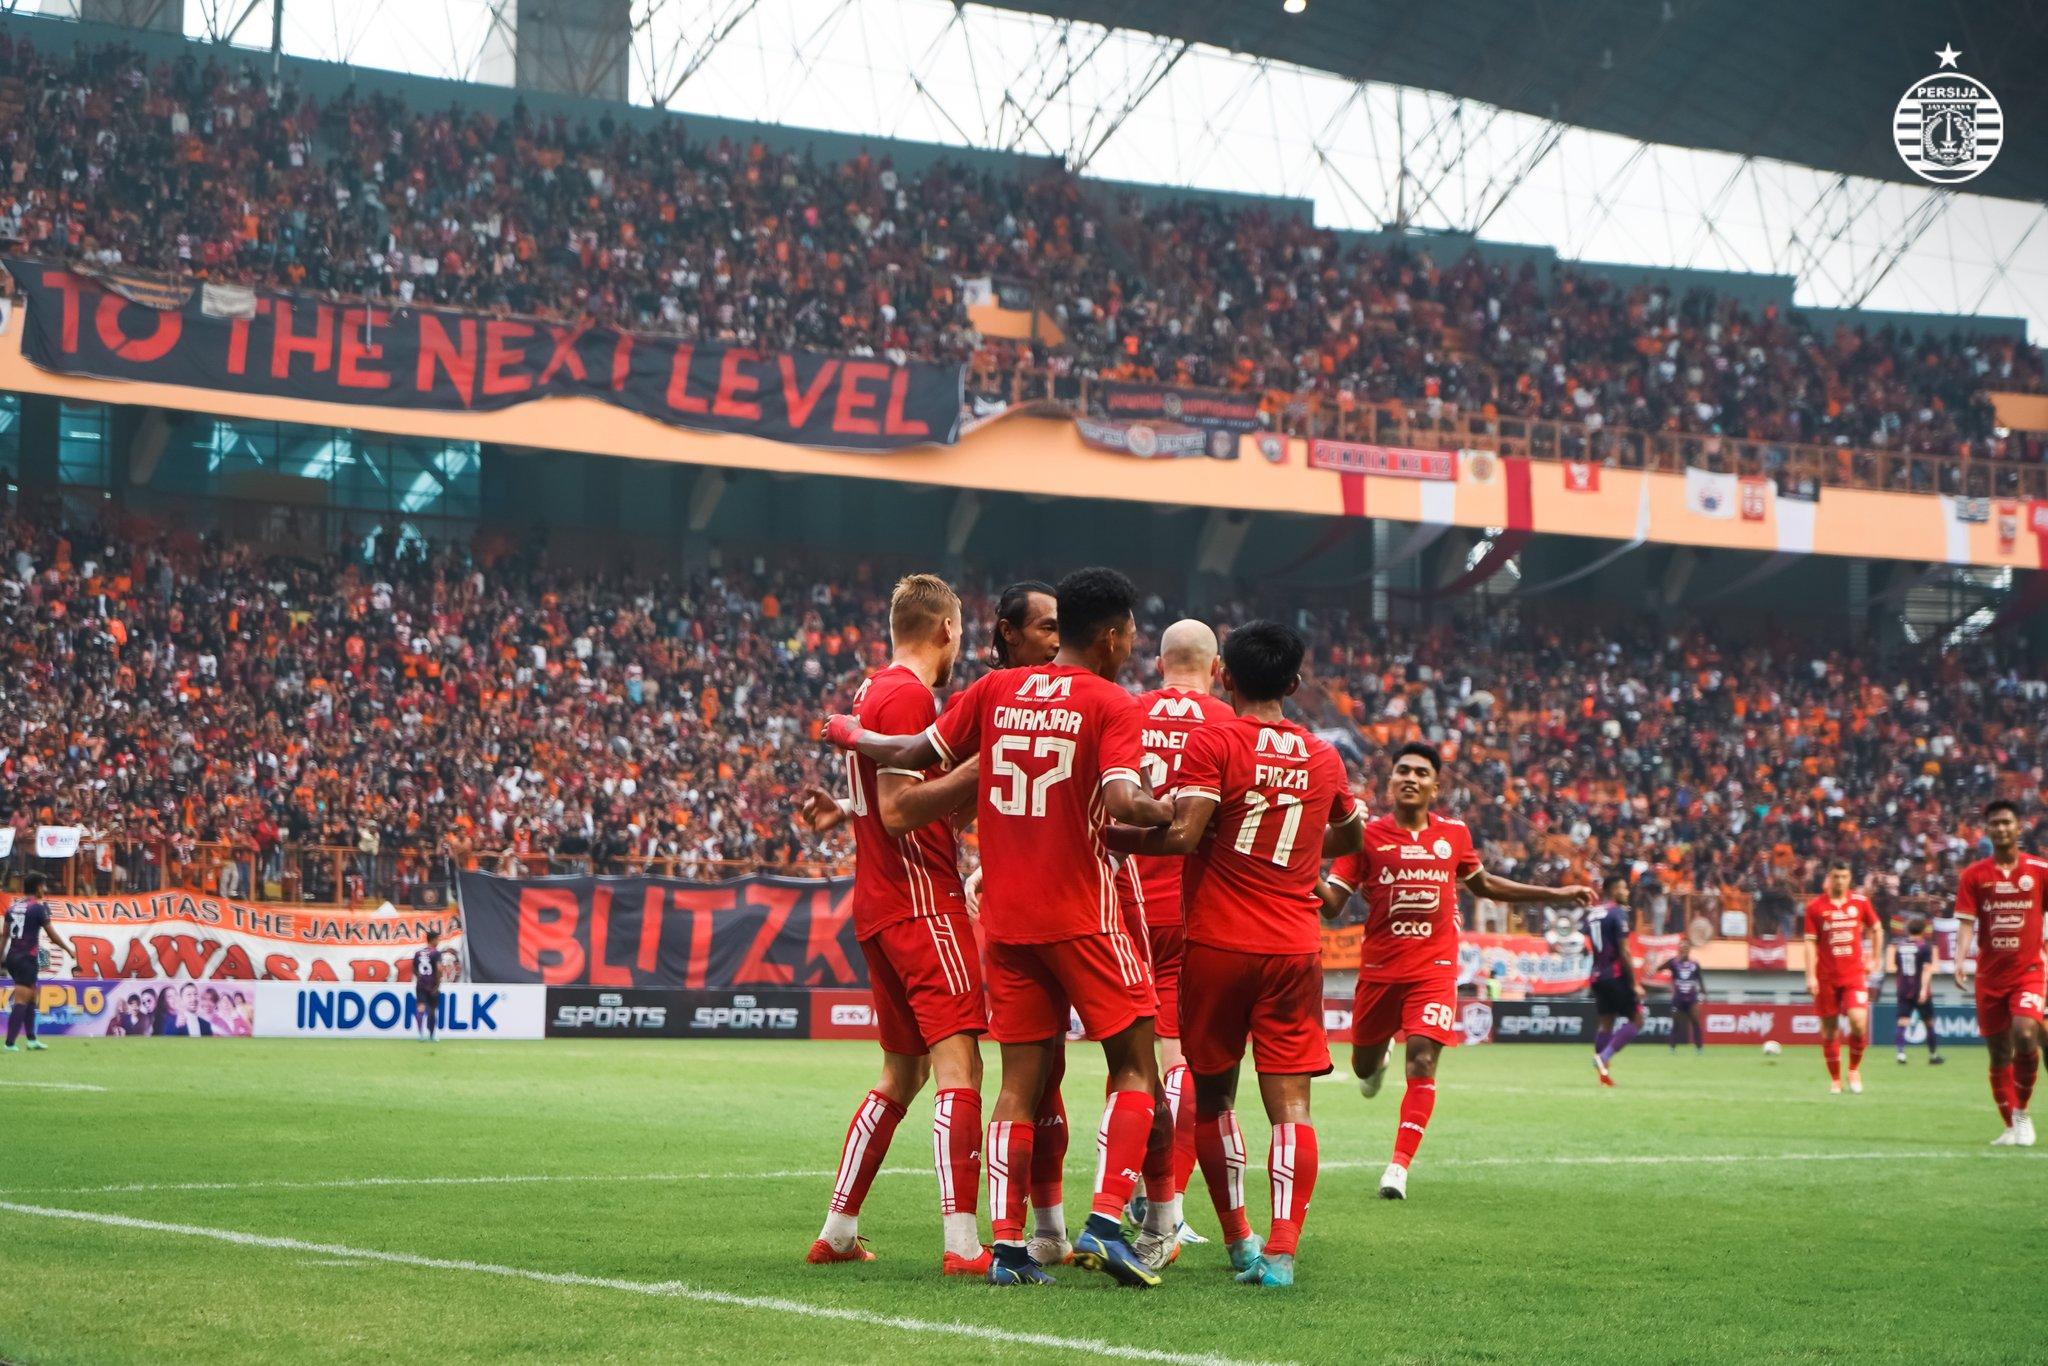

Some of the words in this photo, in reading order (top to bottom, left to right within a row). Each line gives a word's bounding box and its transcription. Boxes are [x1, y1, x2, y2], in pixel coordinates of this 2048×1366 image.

[42, 271, 183, 362] TO
[222, 300, 392, 389] THE
[665, 343, 930, 435] LEVEL
[993, 706, 1082, 734] GINANJAR
[989, 734, 1077, 817] 57
[1255, 764, 1308, 790] FIRZA
[1234, 790, 1304, 867] 11
[1396, 868, 1449, 883] AMMAN
[48, 891, 220, 921] ENTALITAS
[229, 904, 294, 936] THE
[303, 914, 462, 942] JAKMANIA
[1992, 900, 2033, 910] AMMAN
[0, 985, 105, 1014] KPLO
[552, 1006, 667, 1028] SPORTS
[690, 1007, 798, 1028] SPORTS
[1421, 1002, 1453, 1031] 58
[1499, 1016, 1583, 1035] SPORTS
